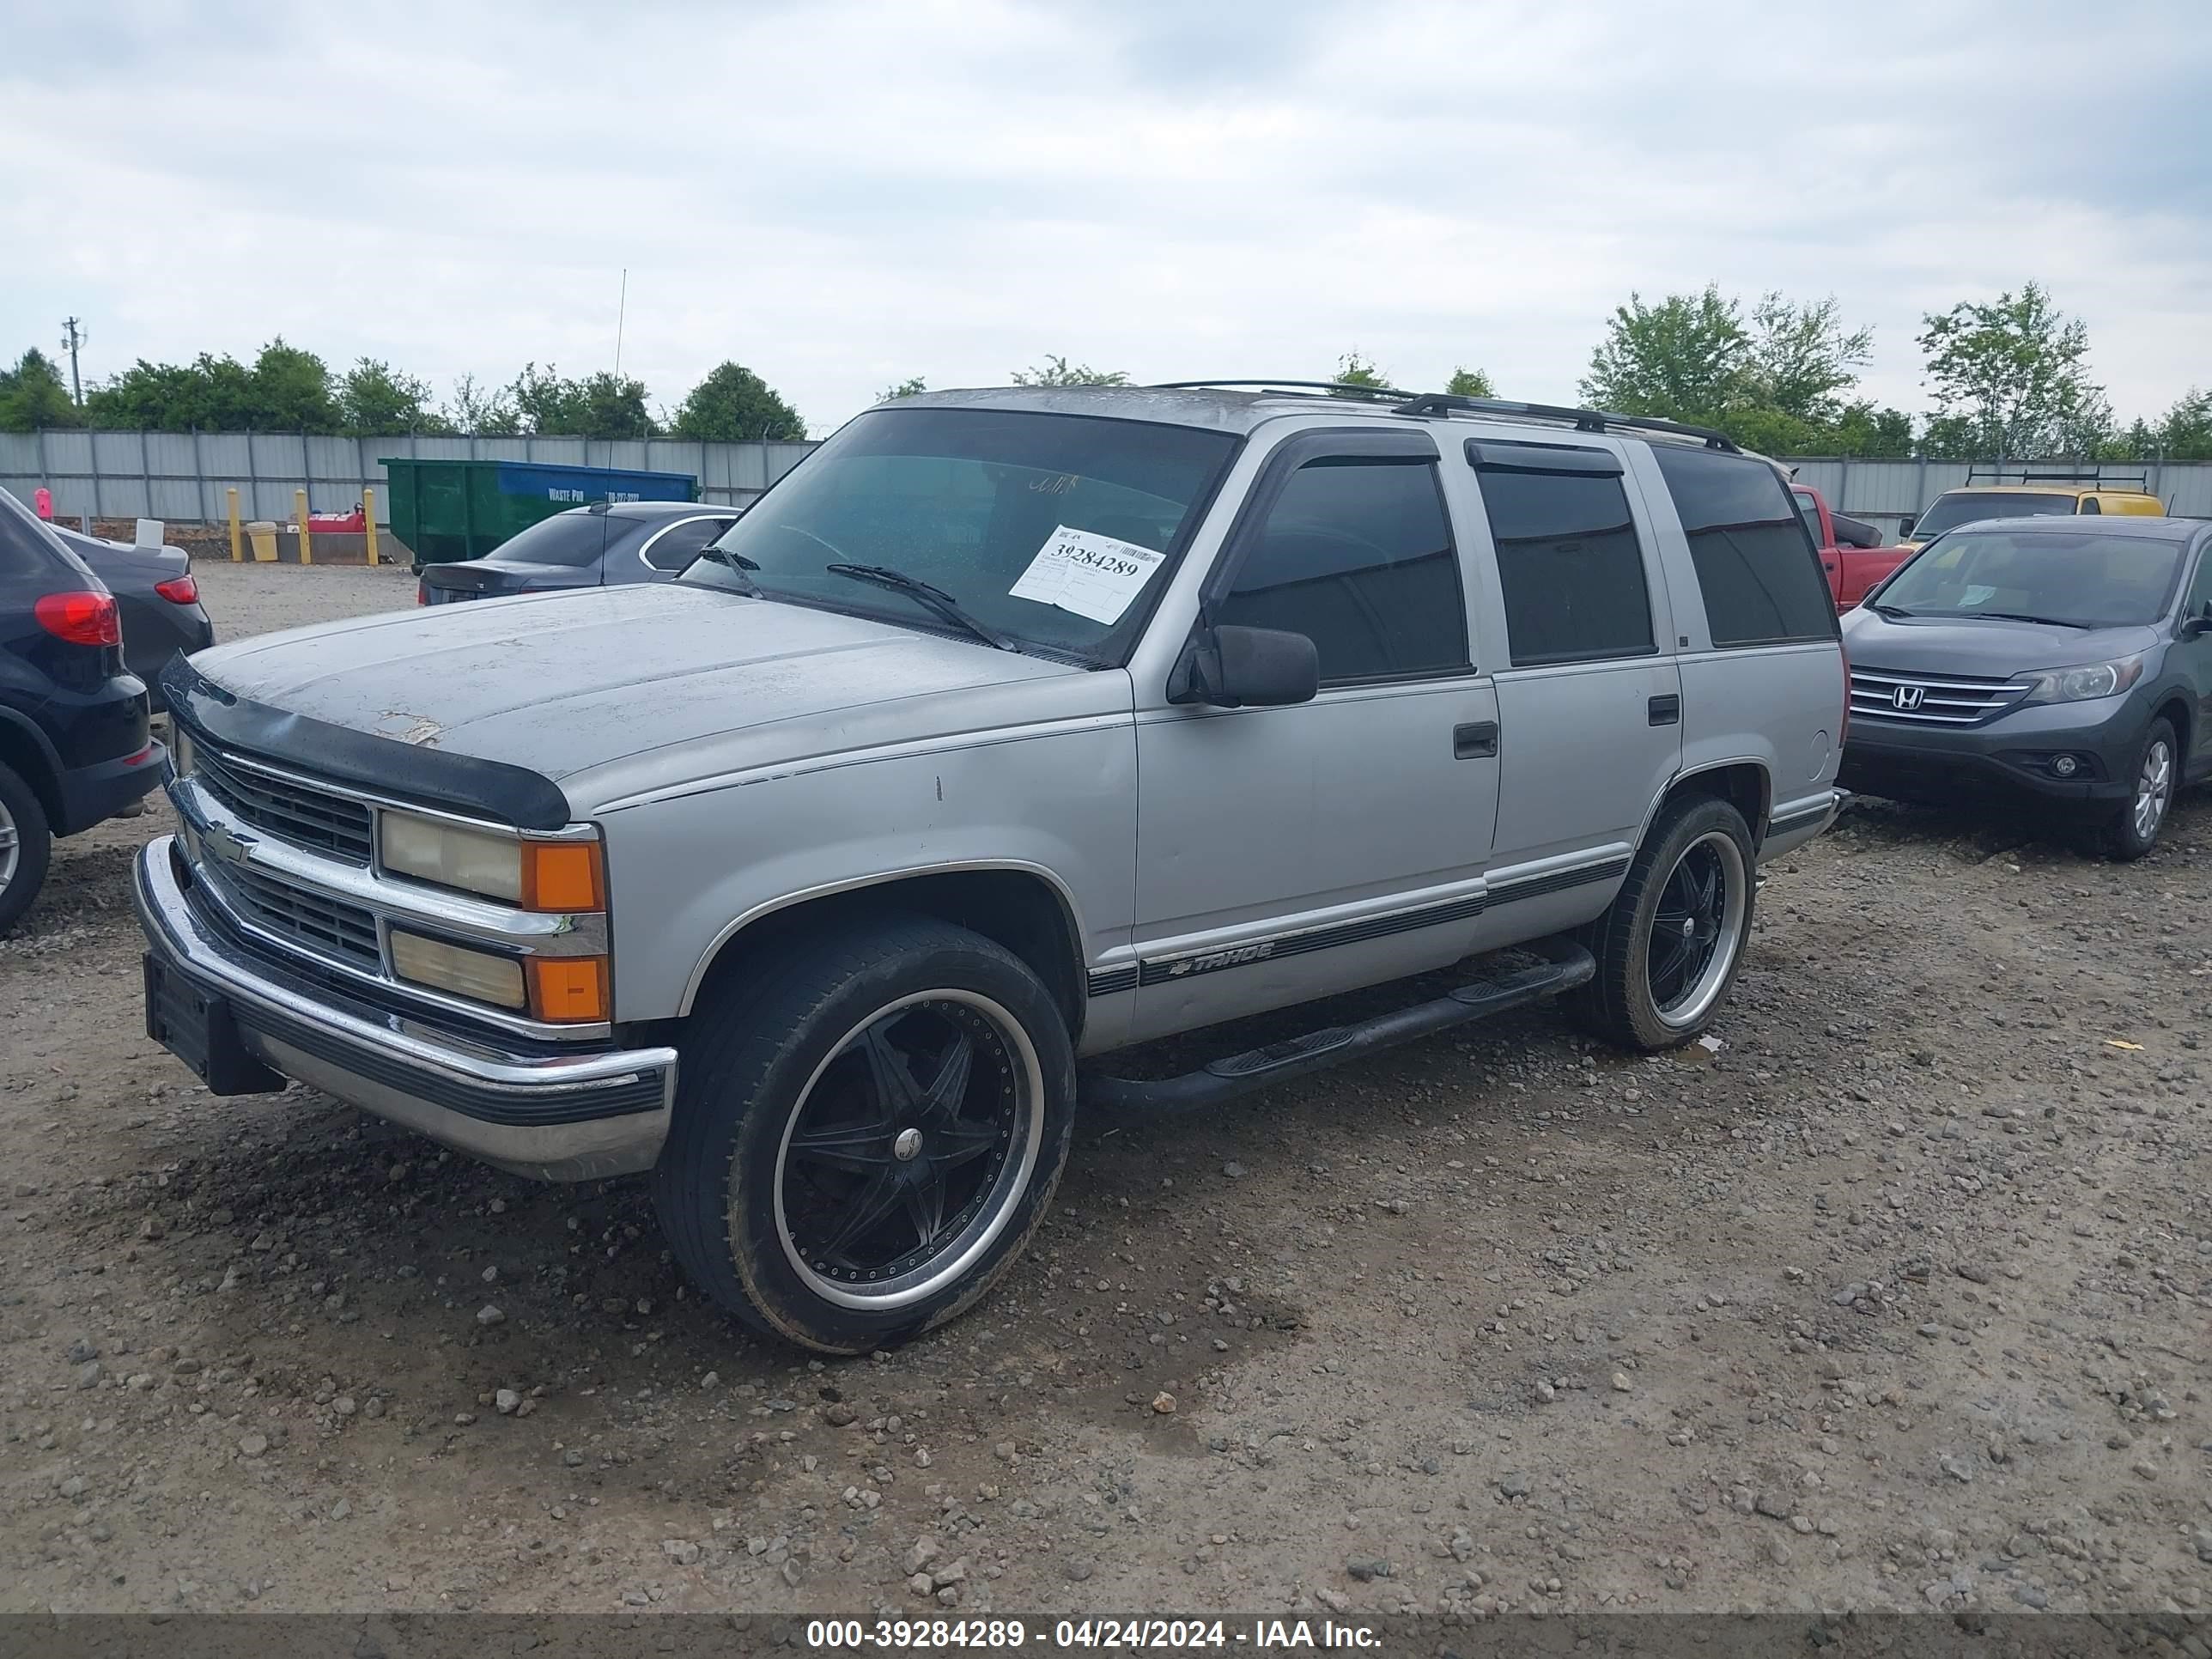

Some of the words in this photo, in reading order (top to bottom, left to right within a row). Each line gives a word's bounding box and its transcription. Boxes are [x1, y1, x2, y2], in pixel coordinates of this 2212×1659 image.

[548, 487, 570, 502] WASTE
[1051, 544, 1138, 577] 39284289
[1194, 942, 1274, 971] TAHOE
